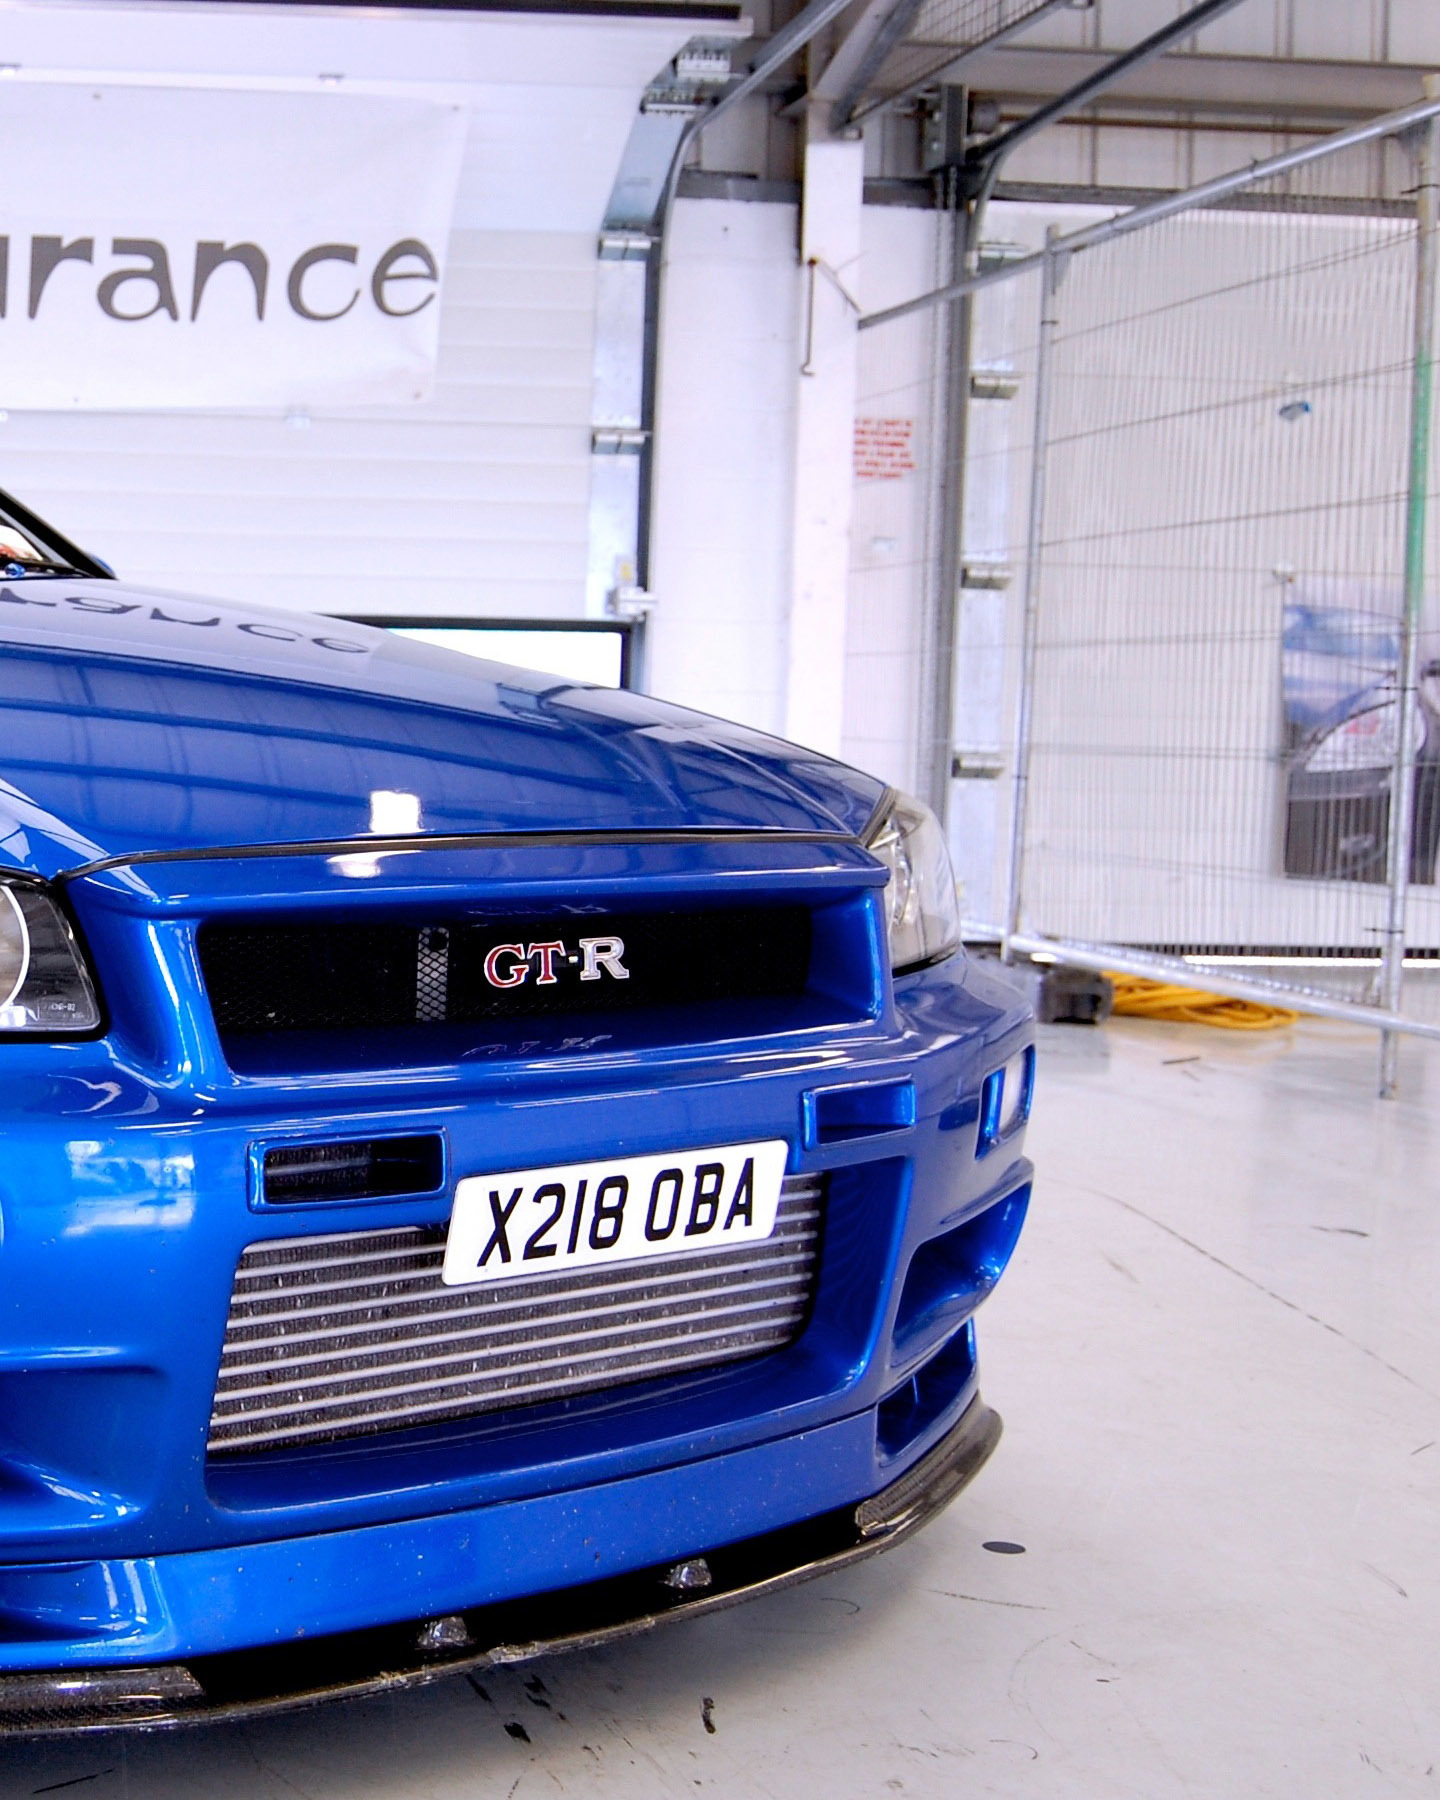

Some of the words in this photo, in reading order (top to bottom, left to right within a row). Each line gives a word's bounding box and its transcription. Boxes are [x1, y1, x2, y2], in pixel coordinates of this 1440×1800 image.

[484, 936, 630, 988] GT-R
[477, 1175, 629, 1267] X218
[644, 1157, 754, 1243] OBA
